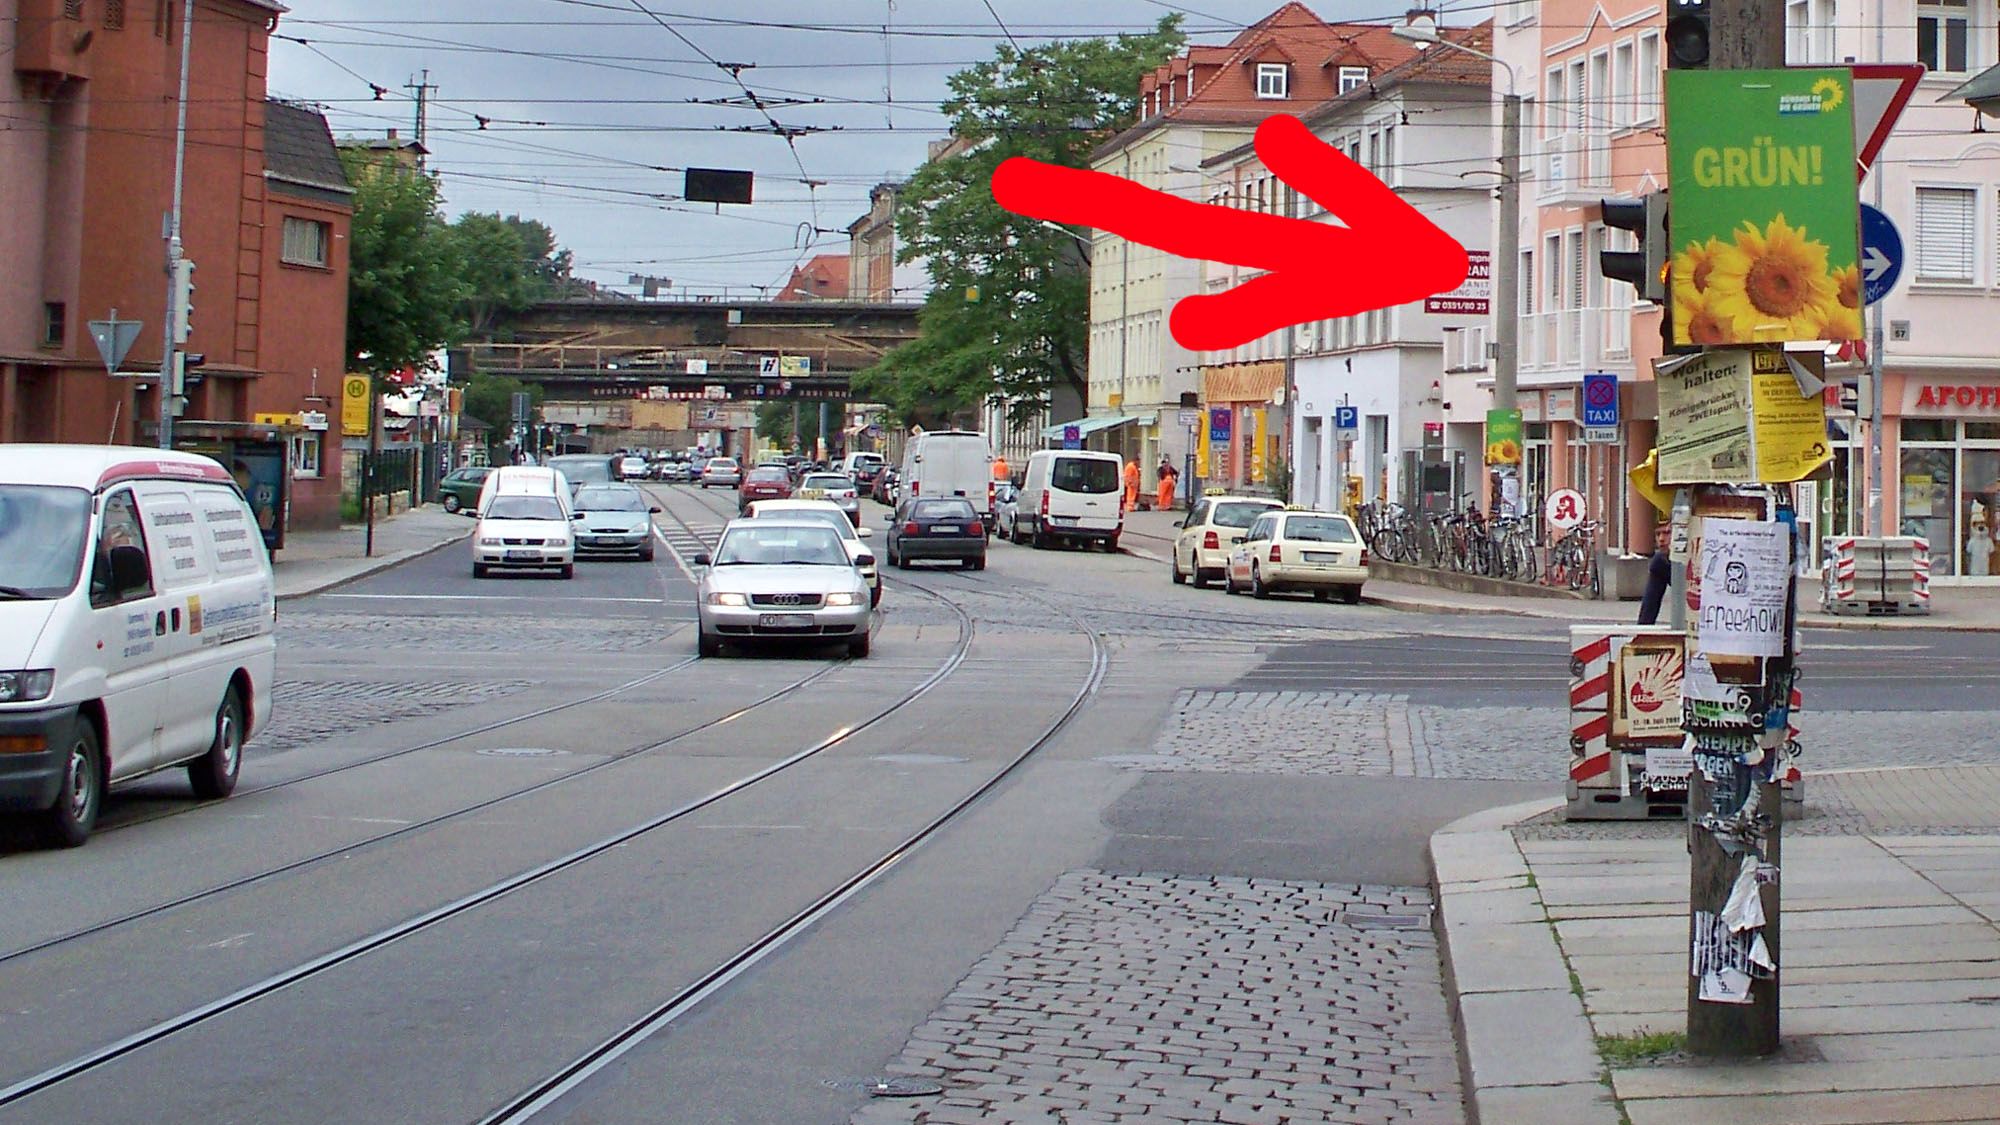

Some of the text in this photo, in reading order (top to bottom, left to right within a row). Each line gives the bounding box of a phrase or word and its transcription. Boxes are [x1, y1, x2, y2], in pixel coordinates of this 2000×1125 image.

[1693, 136, 1823, 187] GRÜN!
[1684, 364, 1737, 390] halten:
[1341, 409, 1353, 427] P
[1587, 410, 1615, 422] TAXI
